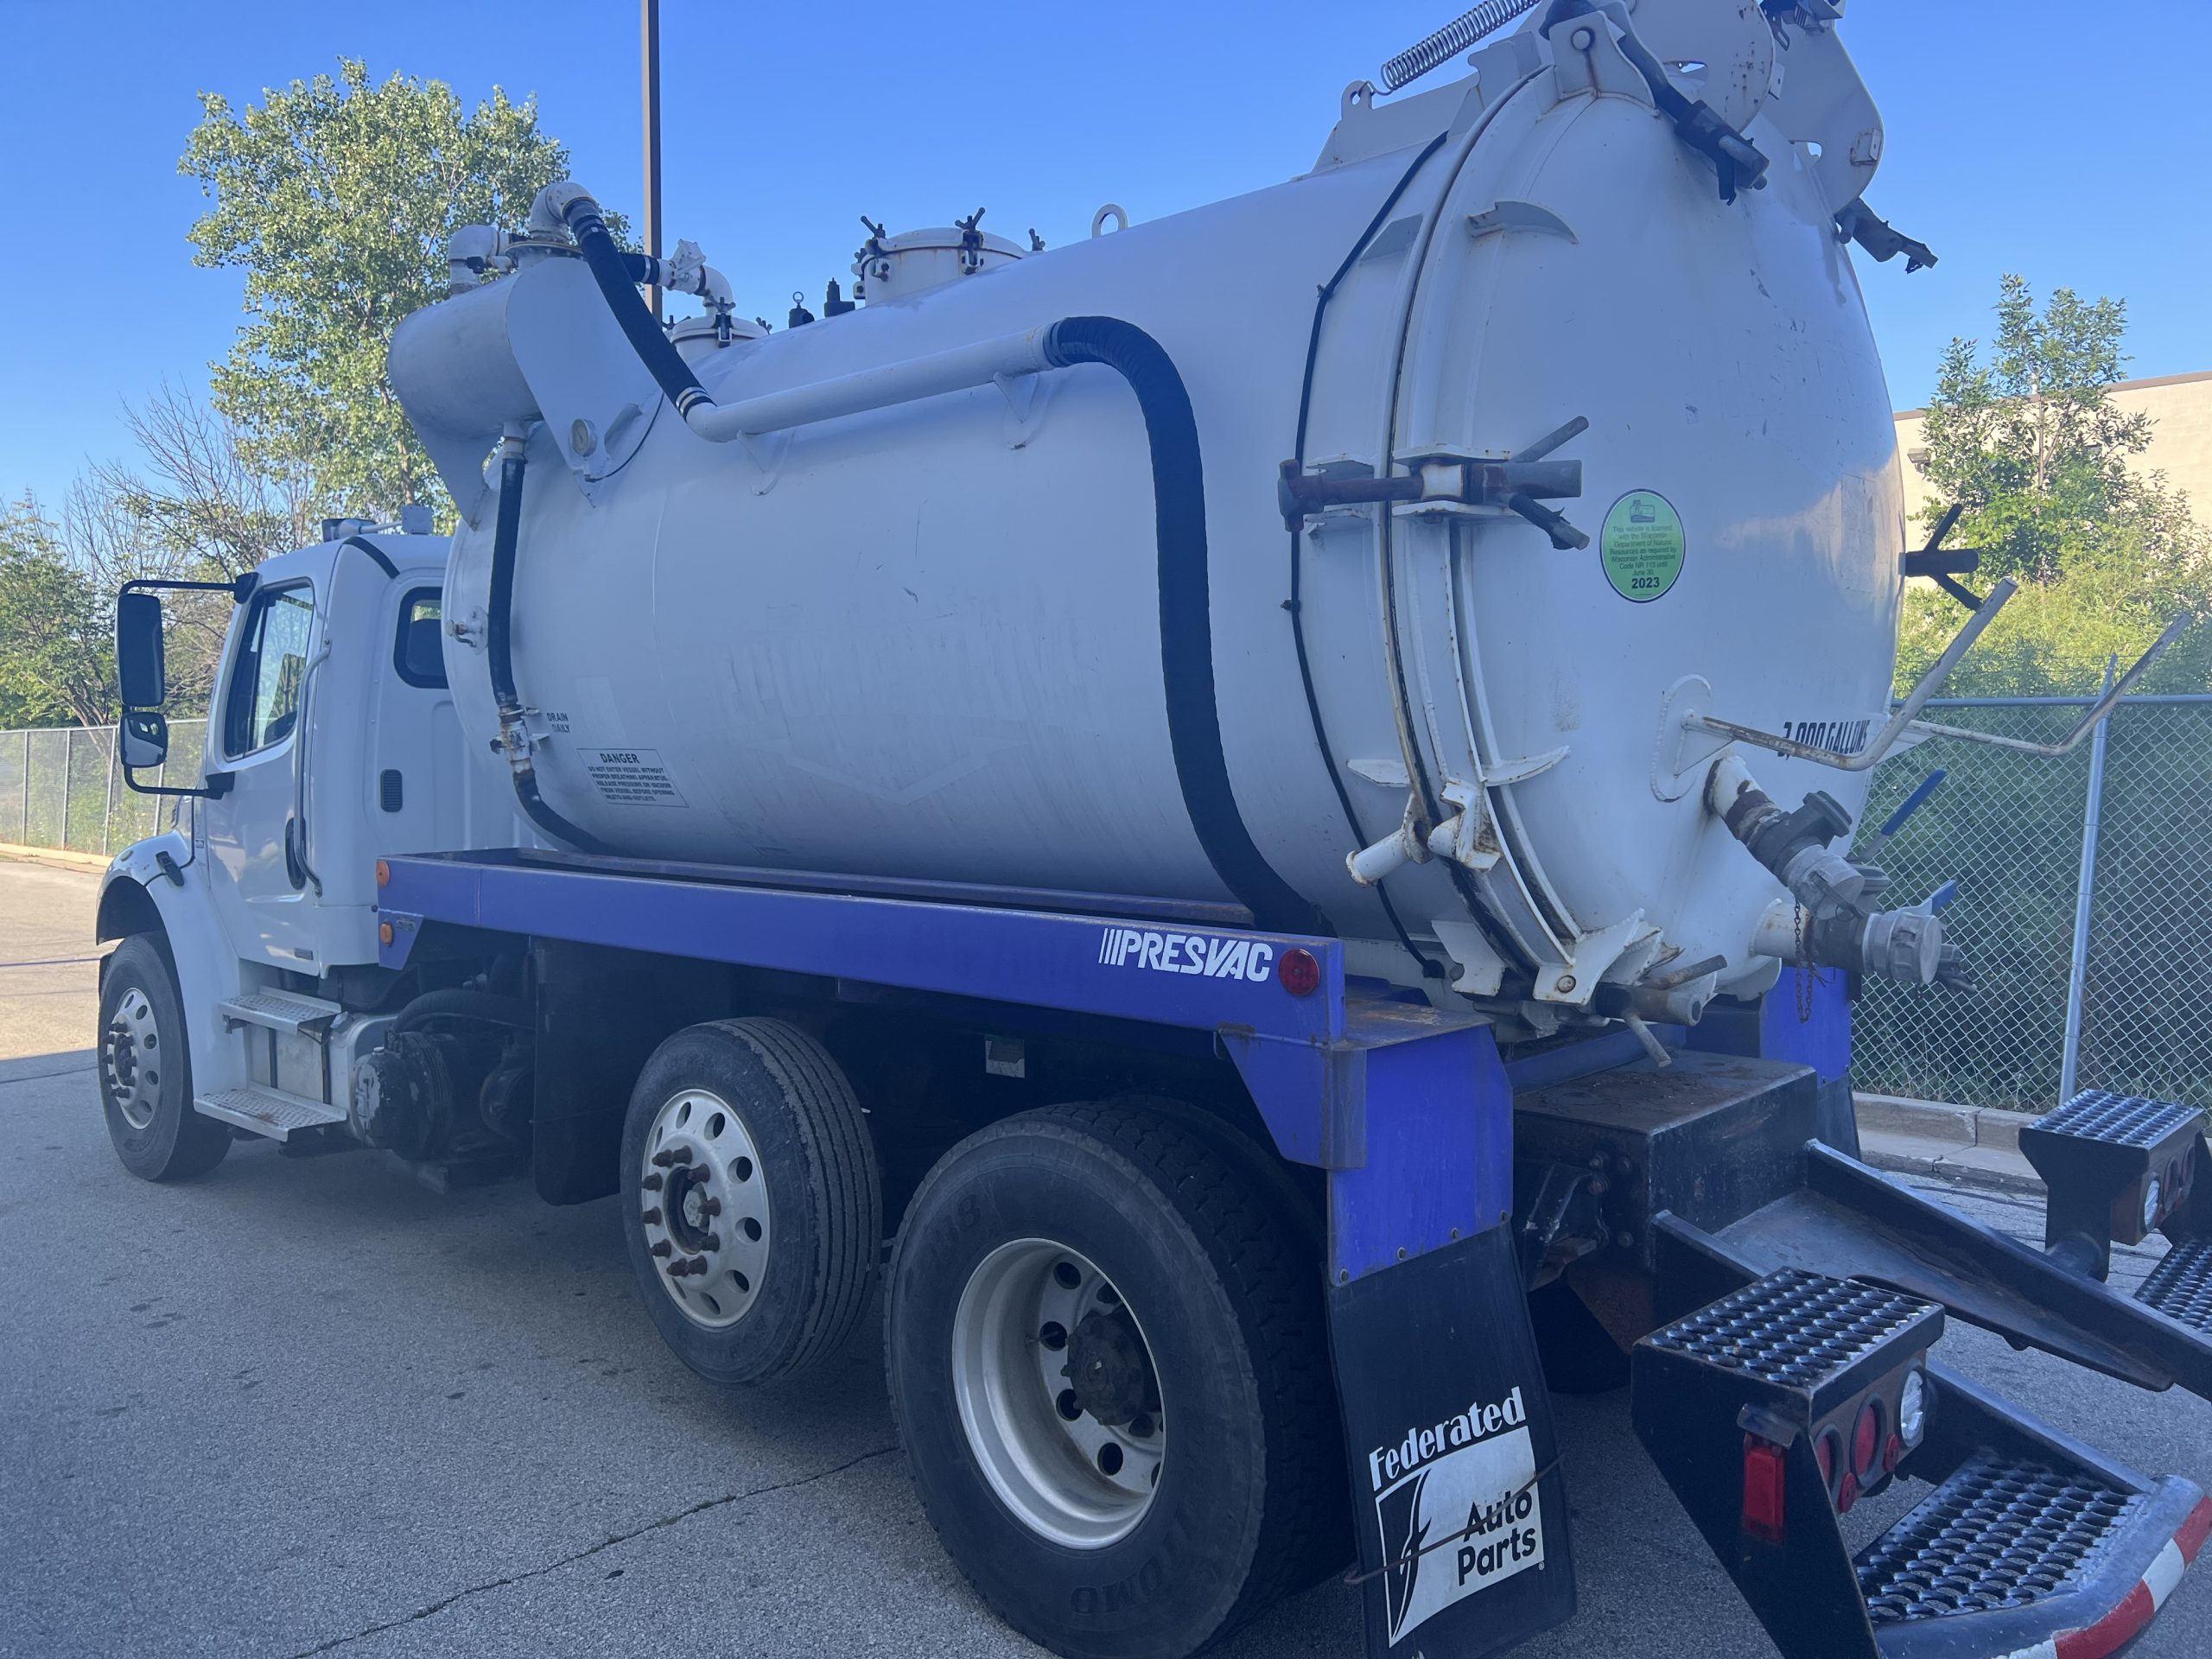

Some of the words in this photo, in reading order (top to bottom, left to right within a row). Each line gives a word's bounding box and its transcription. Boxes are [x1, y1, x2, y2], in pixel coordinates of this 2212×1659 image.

[1614, 540, 1646, 549] Department
[1631, 576, 1660, 589] 2023
[546, 712, 569, 722] DRAIN
[551, 723, 570, 734] DAILY
[1824, 719, 1871, 754] GALLONS
[599, 753, 640, 764] DANGER
[1116, 929, 1274, 982] PRESVAC
[1369, 1386, 1527, 1492] Federated
[1463, 1490, 1532, 1543] Auto
[1458, 1528, 1536, 1587] Parts
